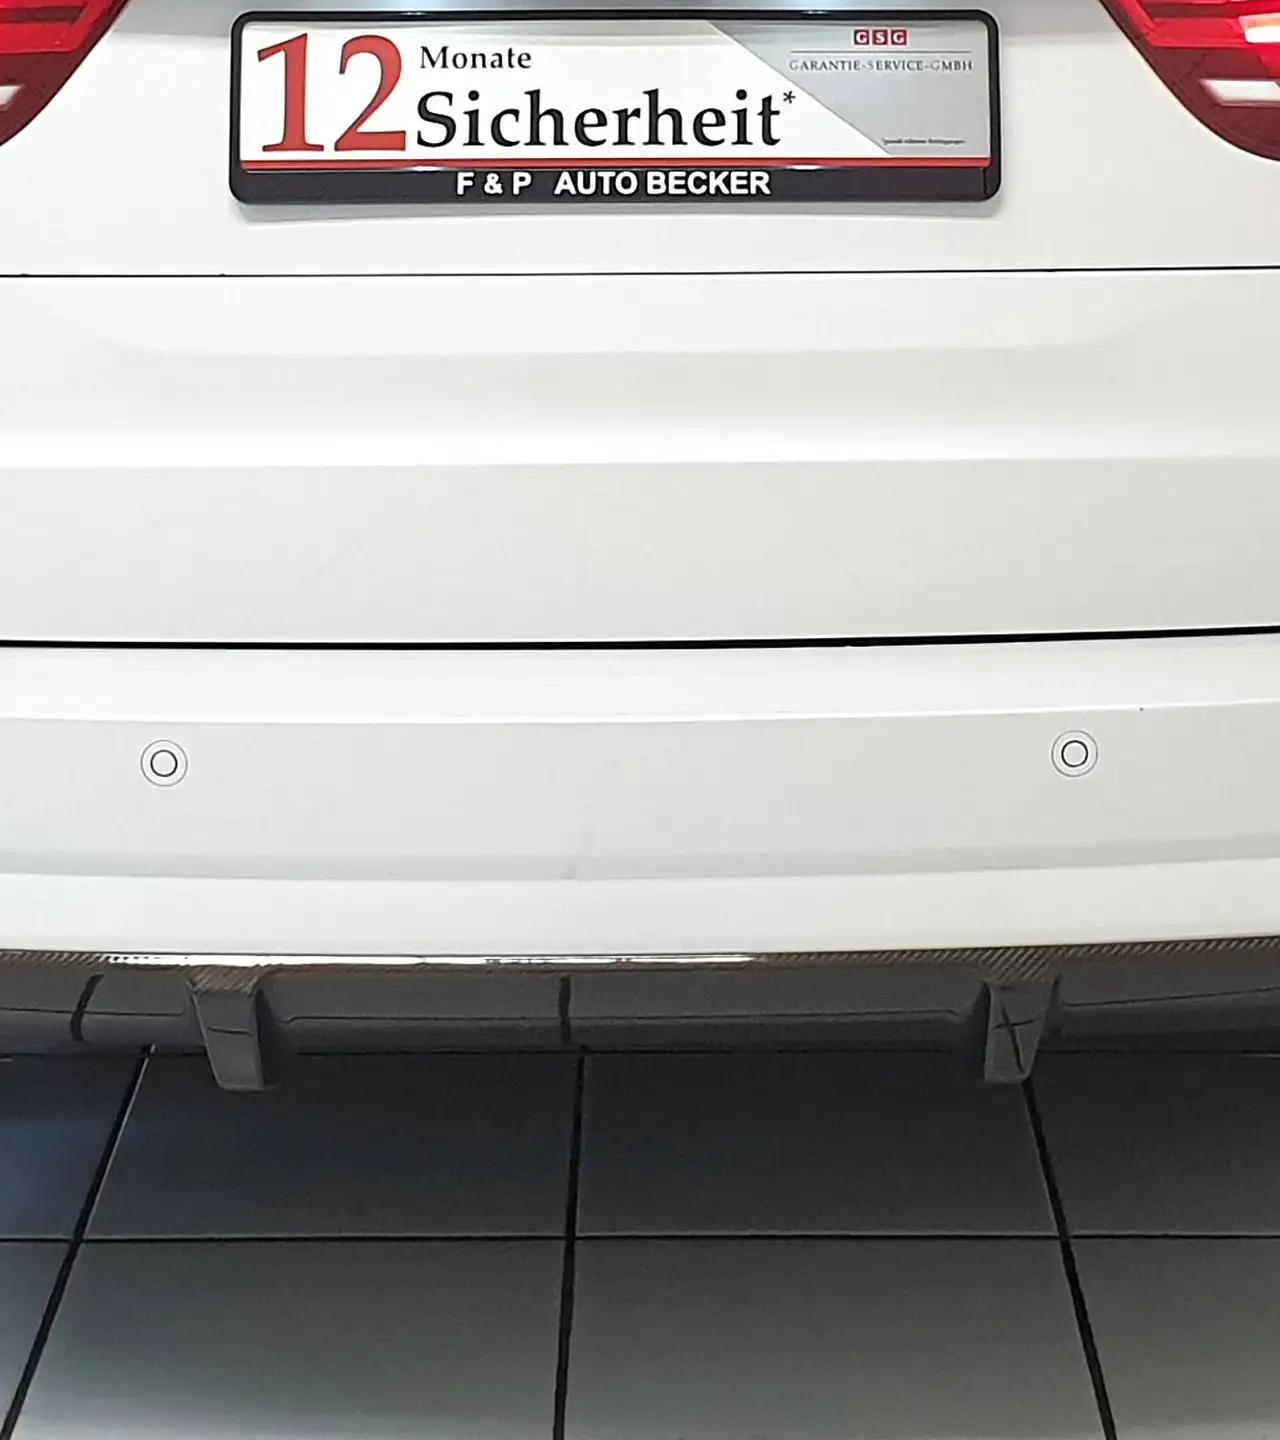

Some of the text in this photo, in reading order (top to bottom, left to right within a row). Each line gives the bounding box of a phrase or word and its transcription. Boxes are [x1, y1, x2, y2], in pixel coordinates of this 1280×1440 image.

[855, 30, 906, 45] GSG
[420, 46, 532, 69] Monate
[257, 32, 406, 152] 12
[456, 171, 771, 195] F & P AUTO BECKER
